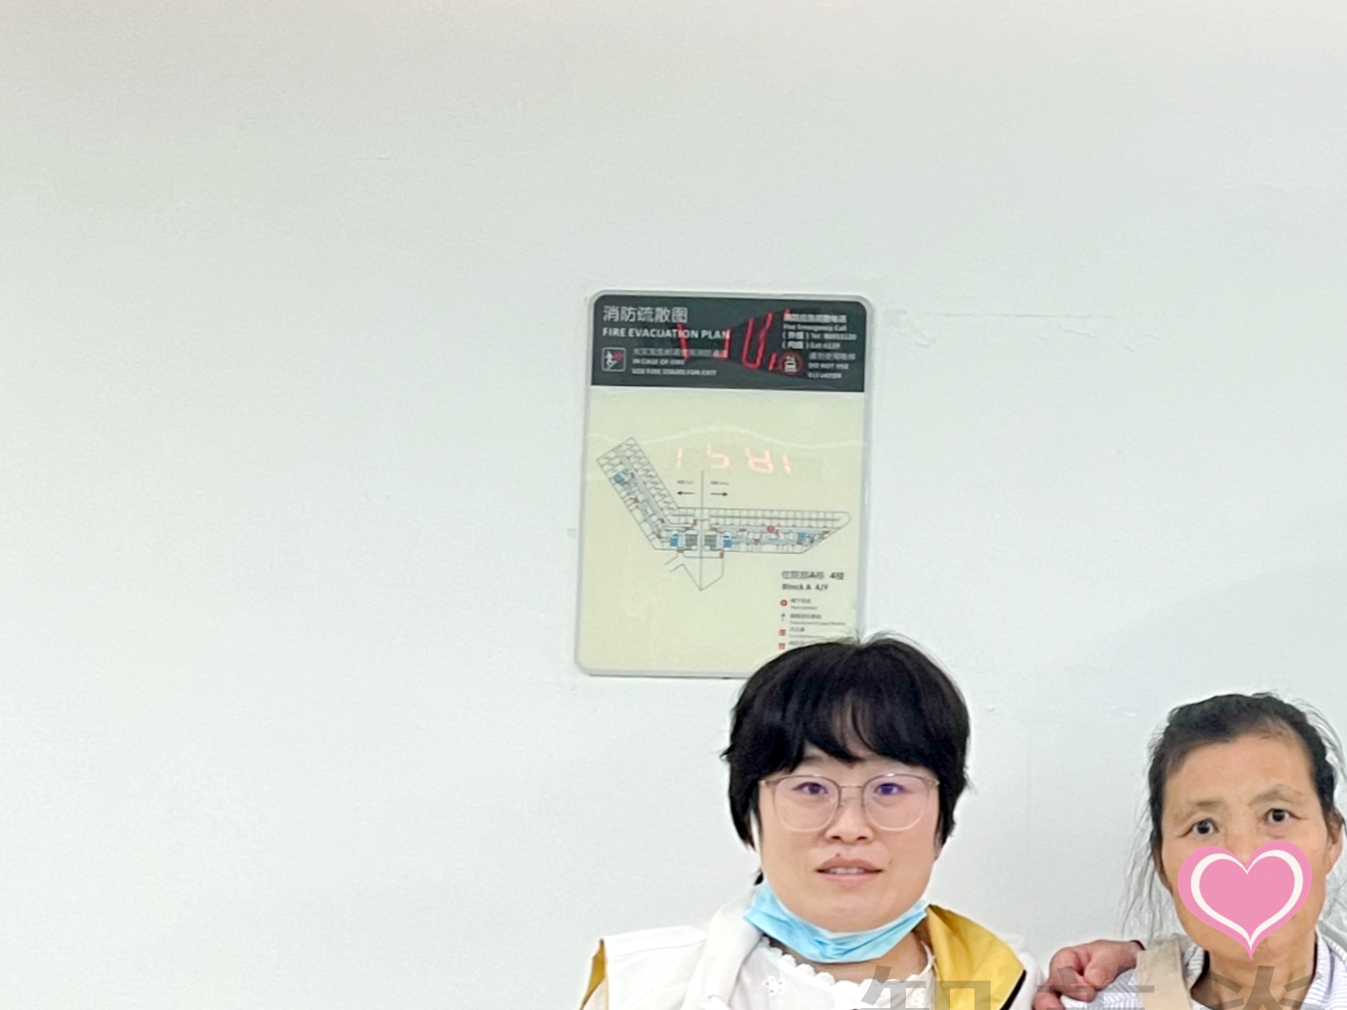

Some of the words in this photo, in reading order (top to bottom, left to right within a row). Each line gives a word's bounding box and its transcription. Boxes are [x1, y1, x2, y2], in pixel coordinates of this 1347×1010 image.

[603, 305, 688, 323] 消防疏散图
[602, 327, 626, 337] FIRE
[628, 328, 699, 338] EVACUATION
[701, 330, 730, 339] PLAN
